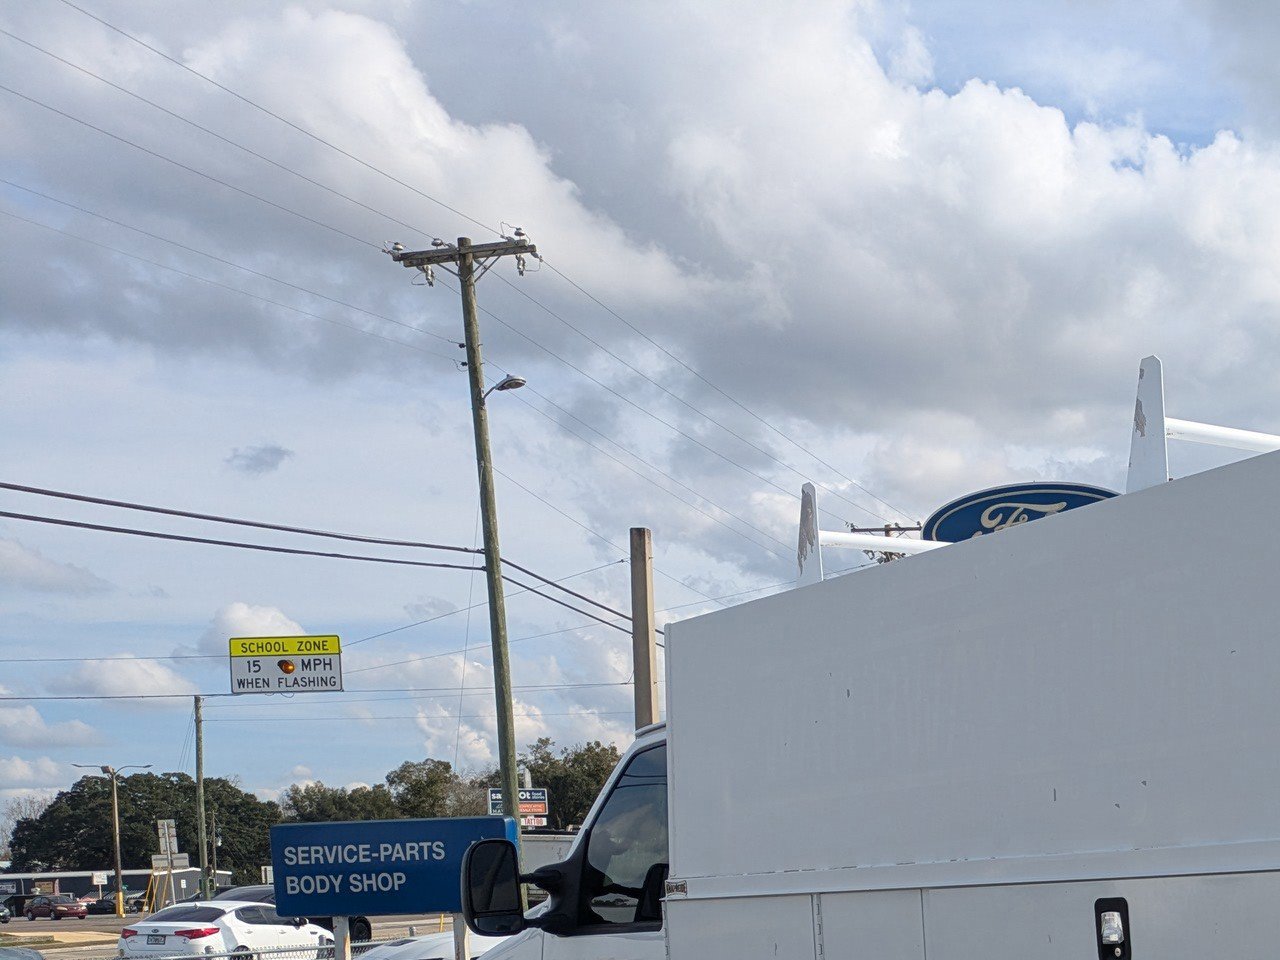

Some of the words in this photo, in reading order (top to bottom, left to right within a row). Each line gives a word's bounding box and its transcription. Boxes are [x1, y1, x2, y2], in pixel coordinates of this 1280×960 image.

[241, 641, 288, 653] SCHOOL
[297, 640, 329, 651] ZONE
[247, 660, 262, 673] 15
[301, 658, 333, 671] MPH
[236, 677, 270, 689] WHEN
[277, 676, 337, 688] FLASHING
[284, 841, 446, 866] SERVICE-PARTS
[286, 875, 343, 895] BODY
[349, 873, 406, 893] SHOP
